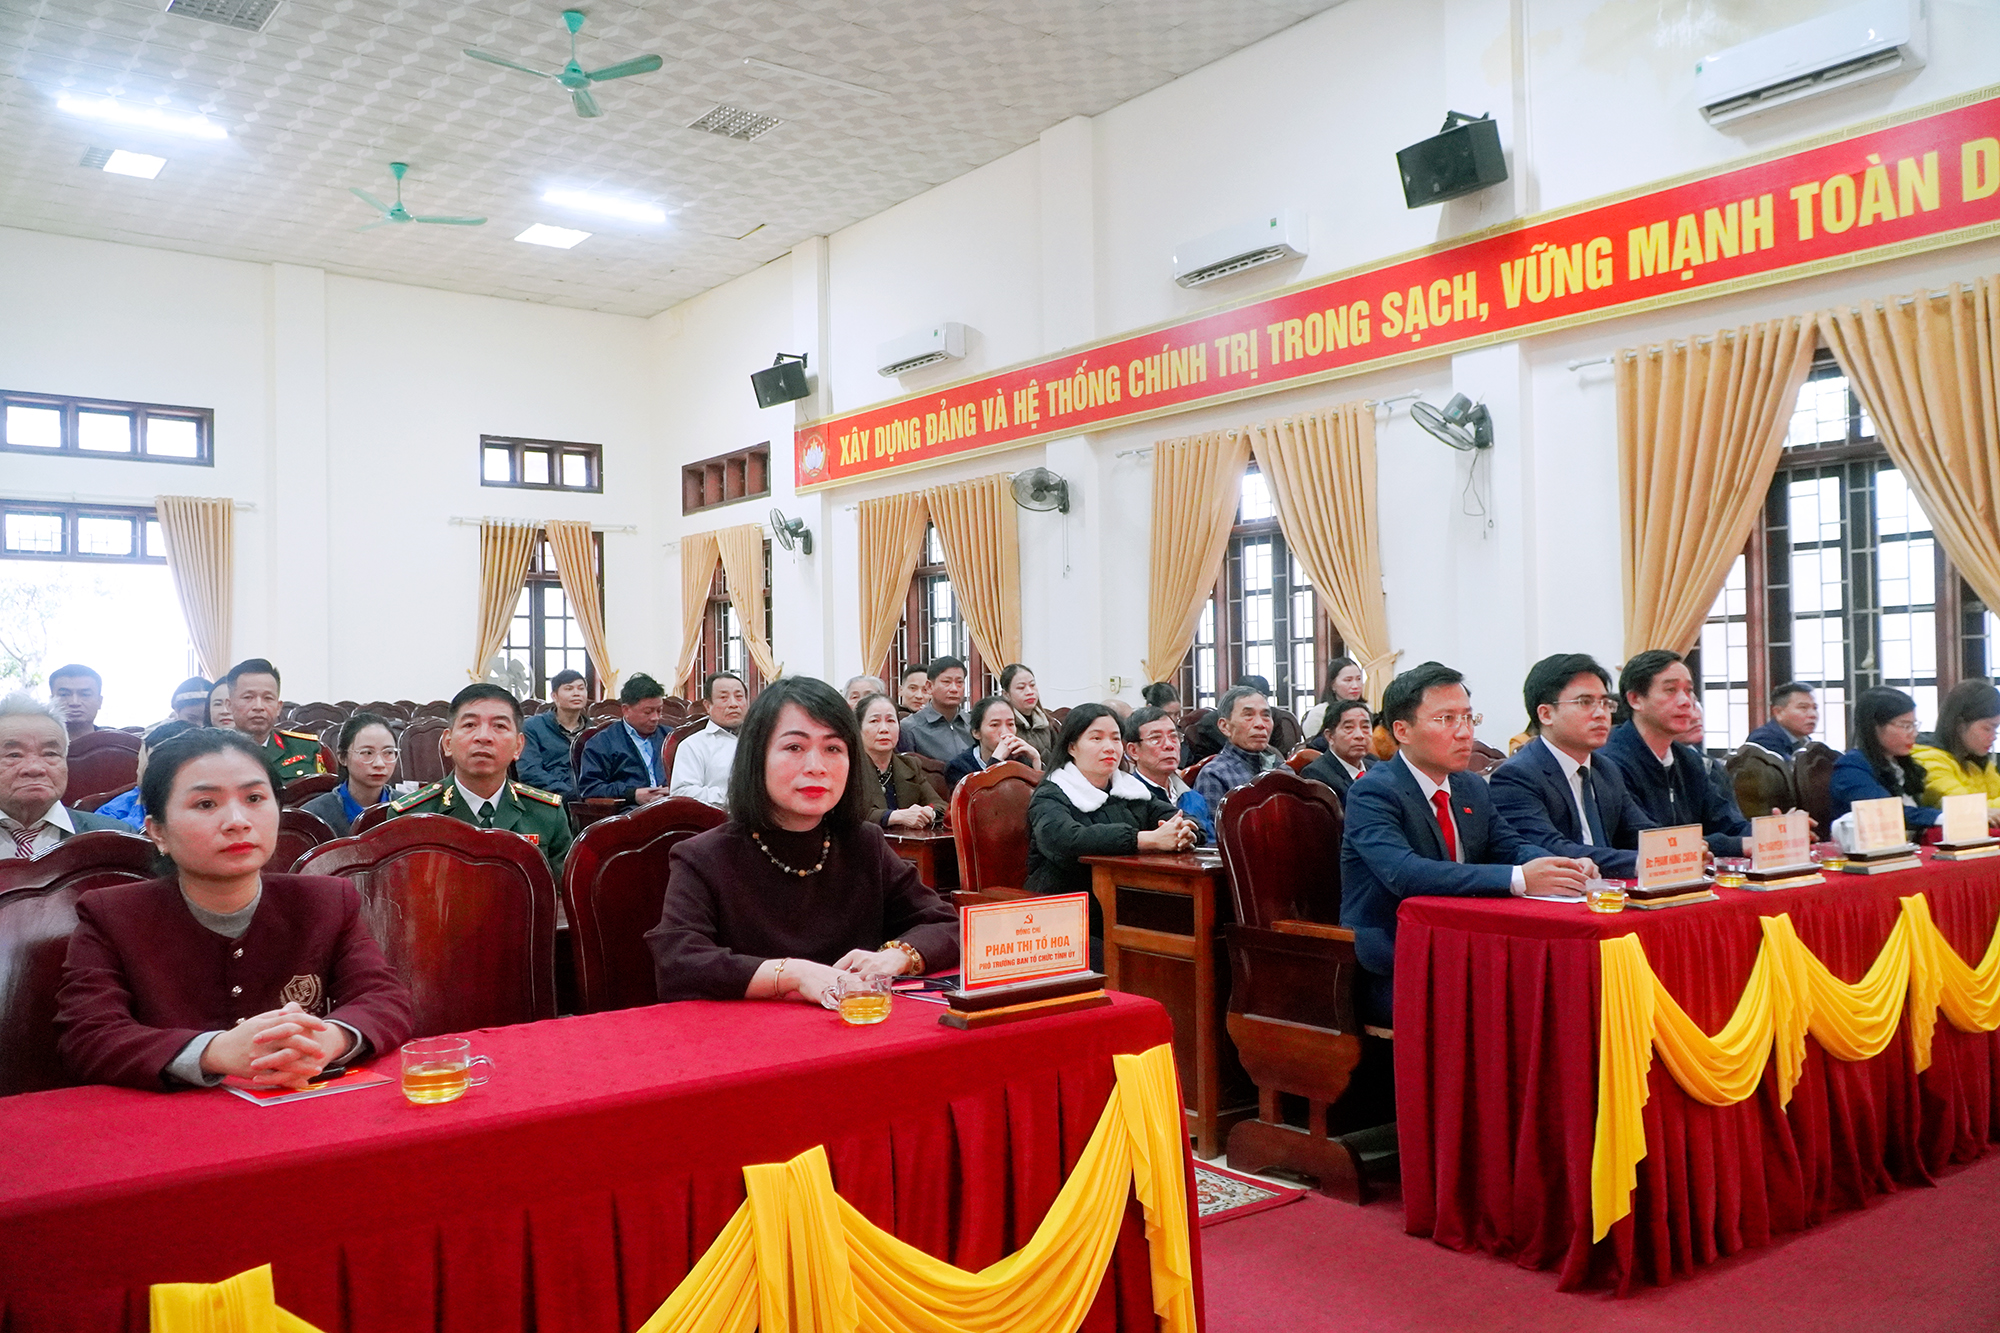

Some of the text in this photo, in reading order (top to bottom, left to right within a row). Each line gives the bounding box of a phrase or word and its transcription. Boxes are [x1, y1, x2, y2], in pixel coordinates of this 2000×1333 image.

[839, 426, 870, 466] XÂY
[875, 417, 921, 462] DỰNG
[925, 399, 977, 446] ĐẢNG
[982, 387, 1008, 432] VÀ
[1013, 378, 1040, 430] HỆ
[1046, 359, 1121, 417] THỐNG
[1128, 343, 1207, 398] CHÍNH
[1215, 328, 1258, 379] TRỊ
[1267, 299, 1370, 365] TRONG
[1381, 270, 1489, 342] SẠCH,
[1500, 236, 1613, 310] VỮNG
[1628, 193, 1774, 281] MẠNH
[1790, 152, 1940, 241] TOÀN
[985, 934, 1070, 957] PHAN THỊ TỐ HOA
[1016, 956, 1029, 965] BAN
